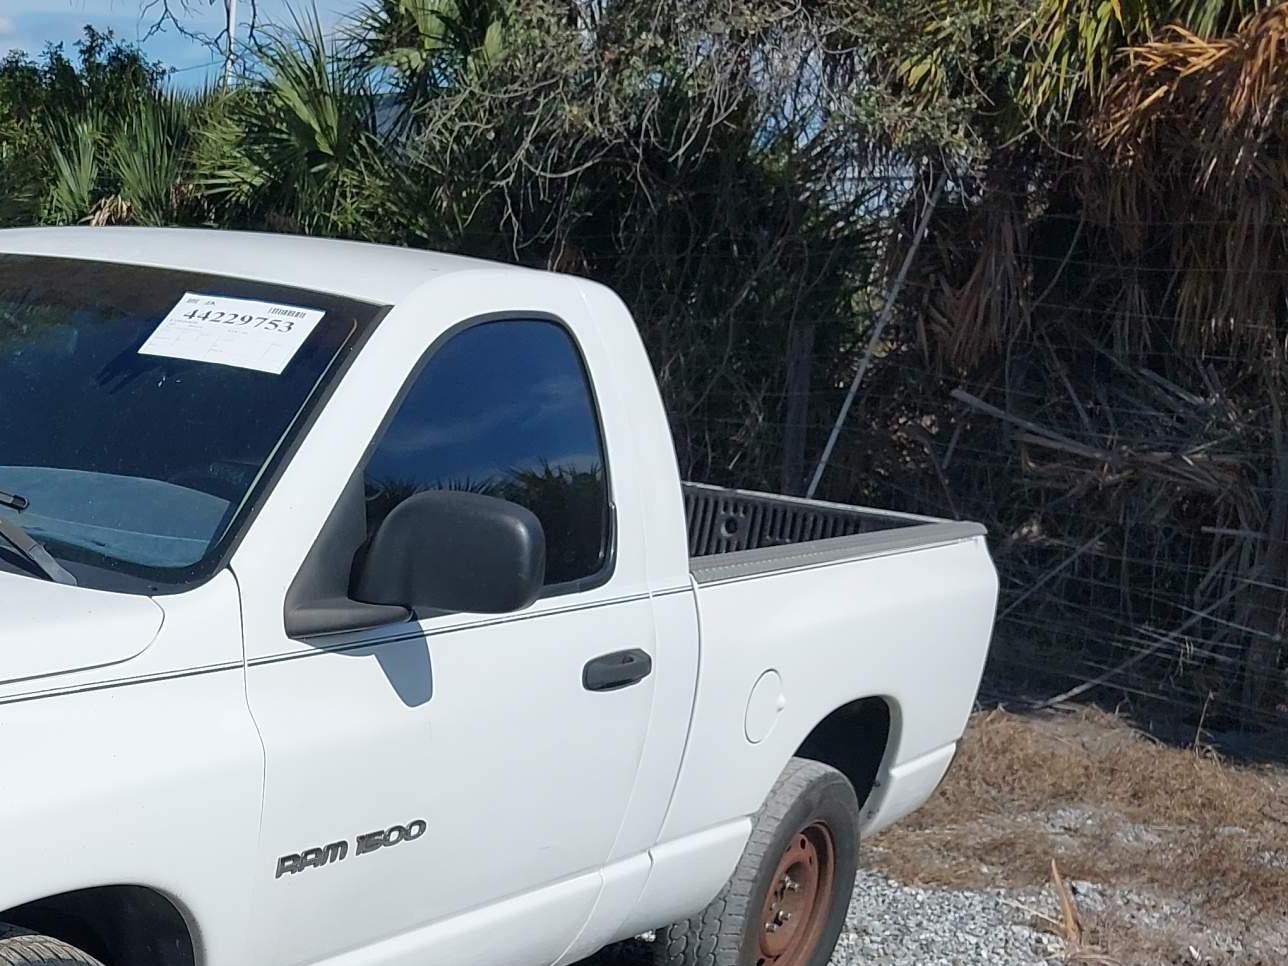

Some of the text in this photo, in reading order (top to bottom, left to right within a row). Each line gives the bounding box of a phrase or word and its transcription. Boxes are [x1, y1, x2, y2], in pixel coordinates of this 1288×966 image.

[183, 308, 295, 334] 44229753
[275, 819, 427, 879] RAM 1500
